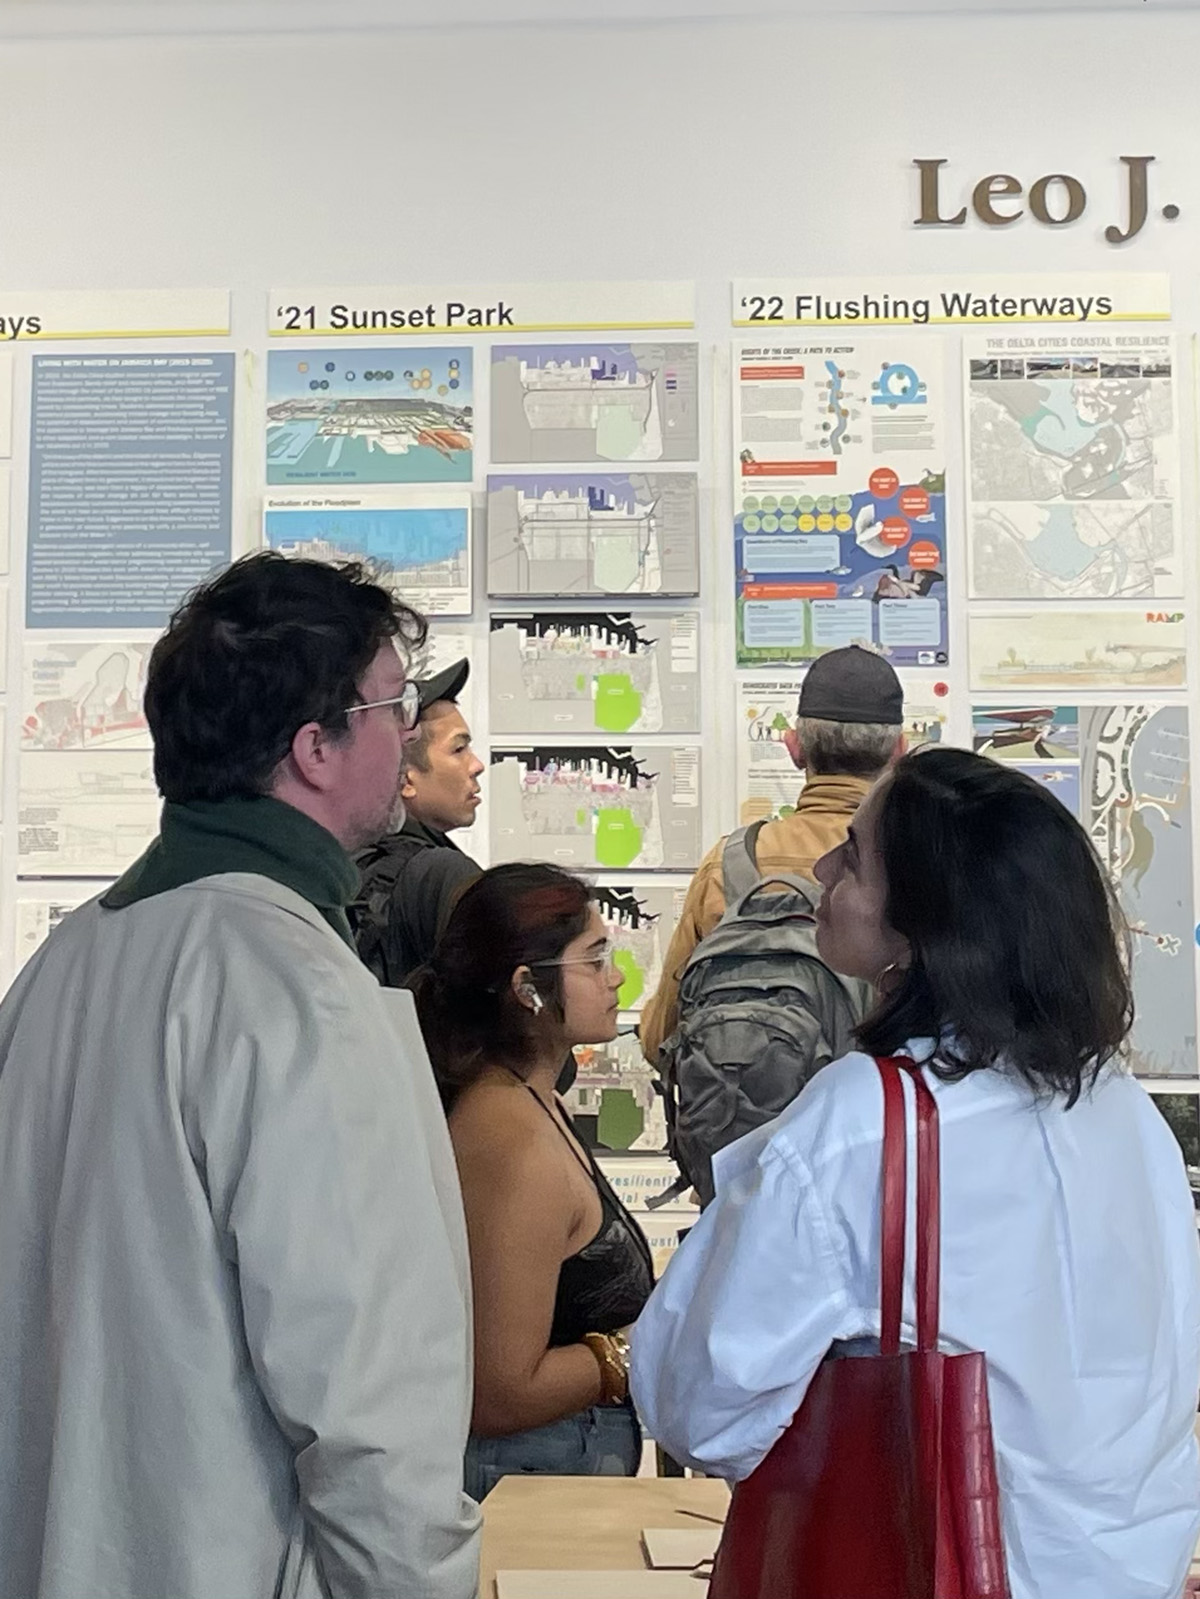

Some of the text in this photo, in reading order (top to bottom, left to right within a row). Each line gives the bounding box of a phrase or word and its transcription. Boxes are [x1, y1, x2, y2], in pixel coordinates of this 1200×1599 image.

[912, 157, 1088, 226] Leo
[1103, 155, 1181, 243] J.
[277, 301, 515, 331] ‘21 Sunset Park
[741, 292, 1112, 324] ‘22 Flushing Waterways
[986, 338, 1004, 348] THE
[1038, 337, 1068, 347] CITIES
[1070, 336, 1111, 347] COASTAL
